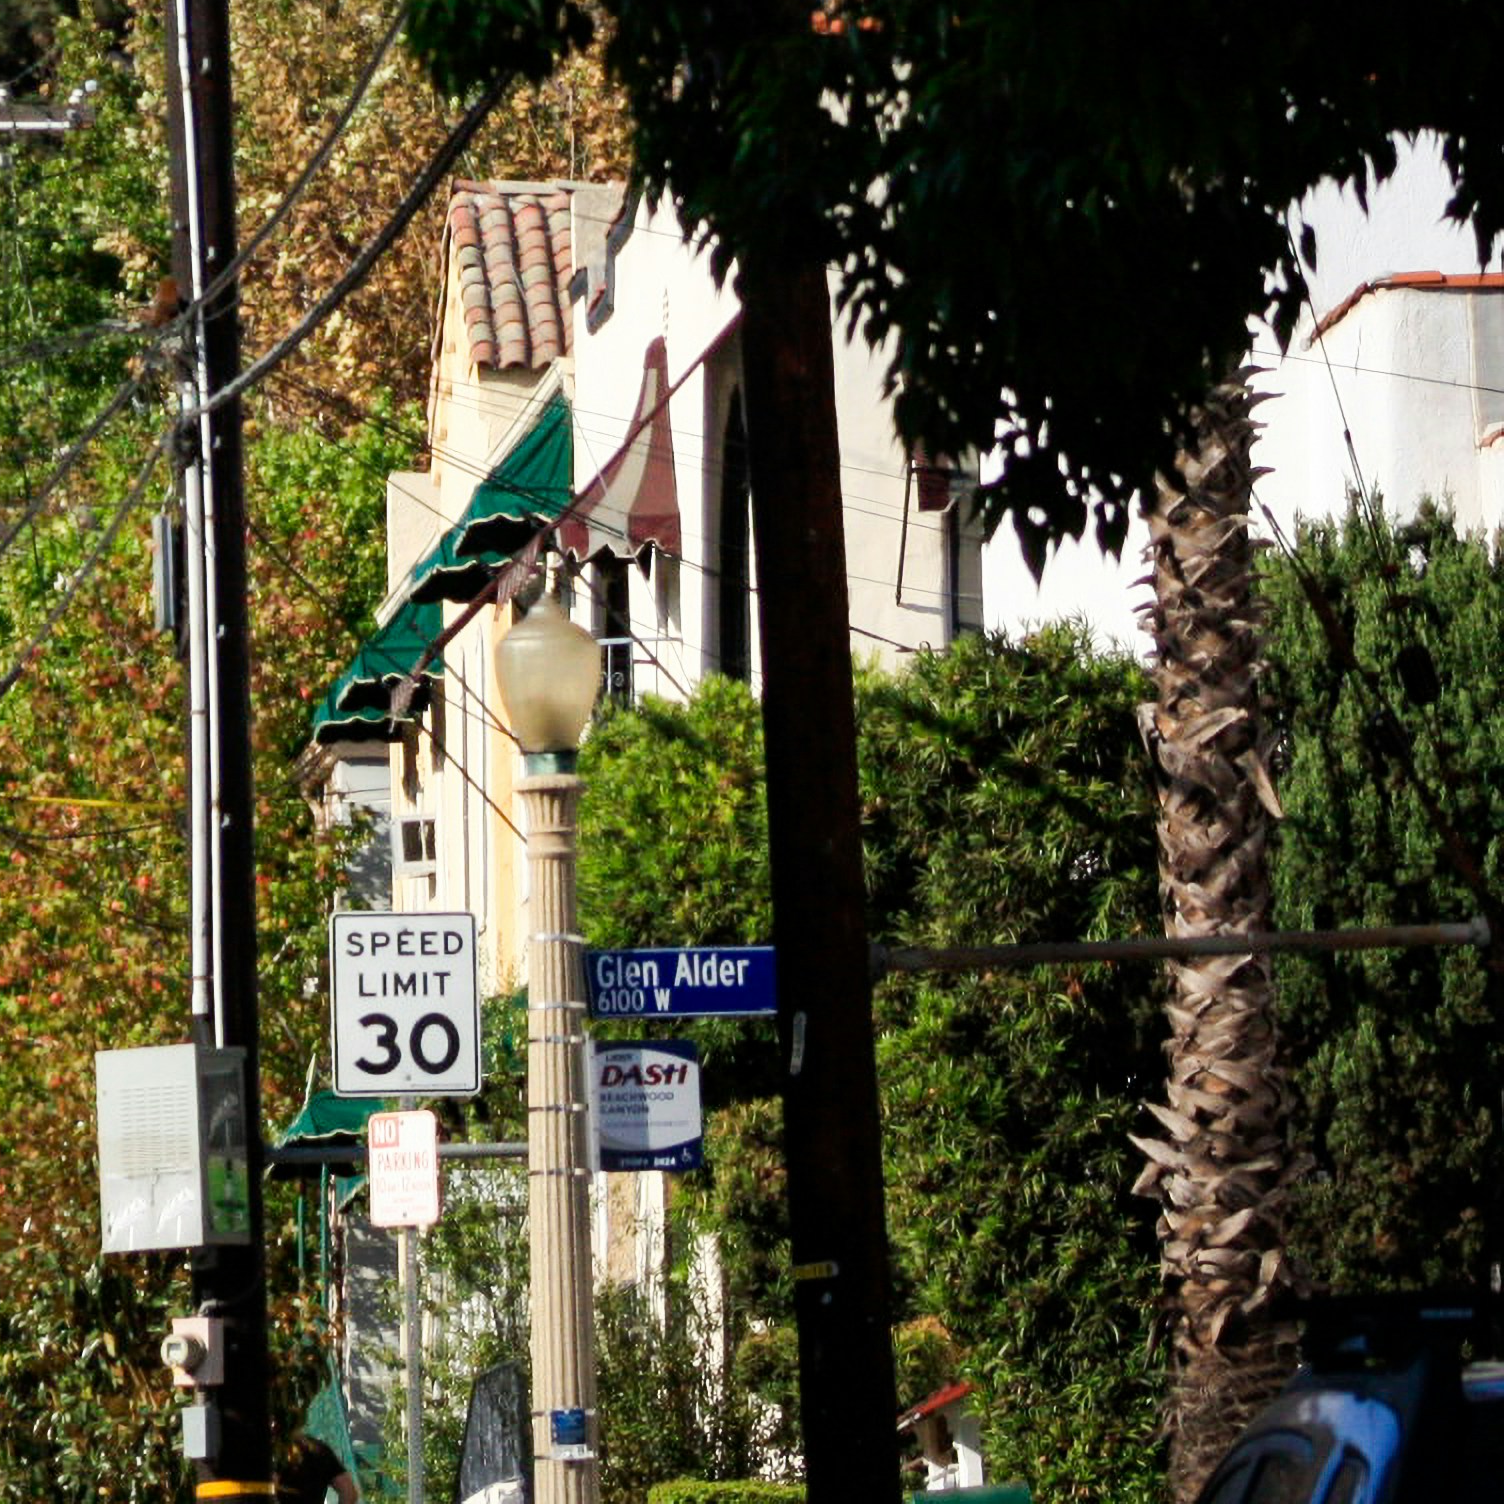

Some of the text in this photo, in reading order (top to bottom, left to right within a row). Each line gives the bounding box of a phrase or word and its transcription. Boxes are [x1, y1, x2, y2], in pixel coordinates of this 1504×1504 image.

[346, 930, 464, 957] SPEED
[596, 952, 750, 989] Glen Alder
[358, 971, 451, 997] LIMIT
[598, 987, 671, 1013] 6100 W
[354, 1011, 461, 1076] 30
[600, 1063, 689, 1087] DASH
[373, 1119, 397, 1144] NO
[377, 1150, 429, 1172] PARKING
